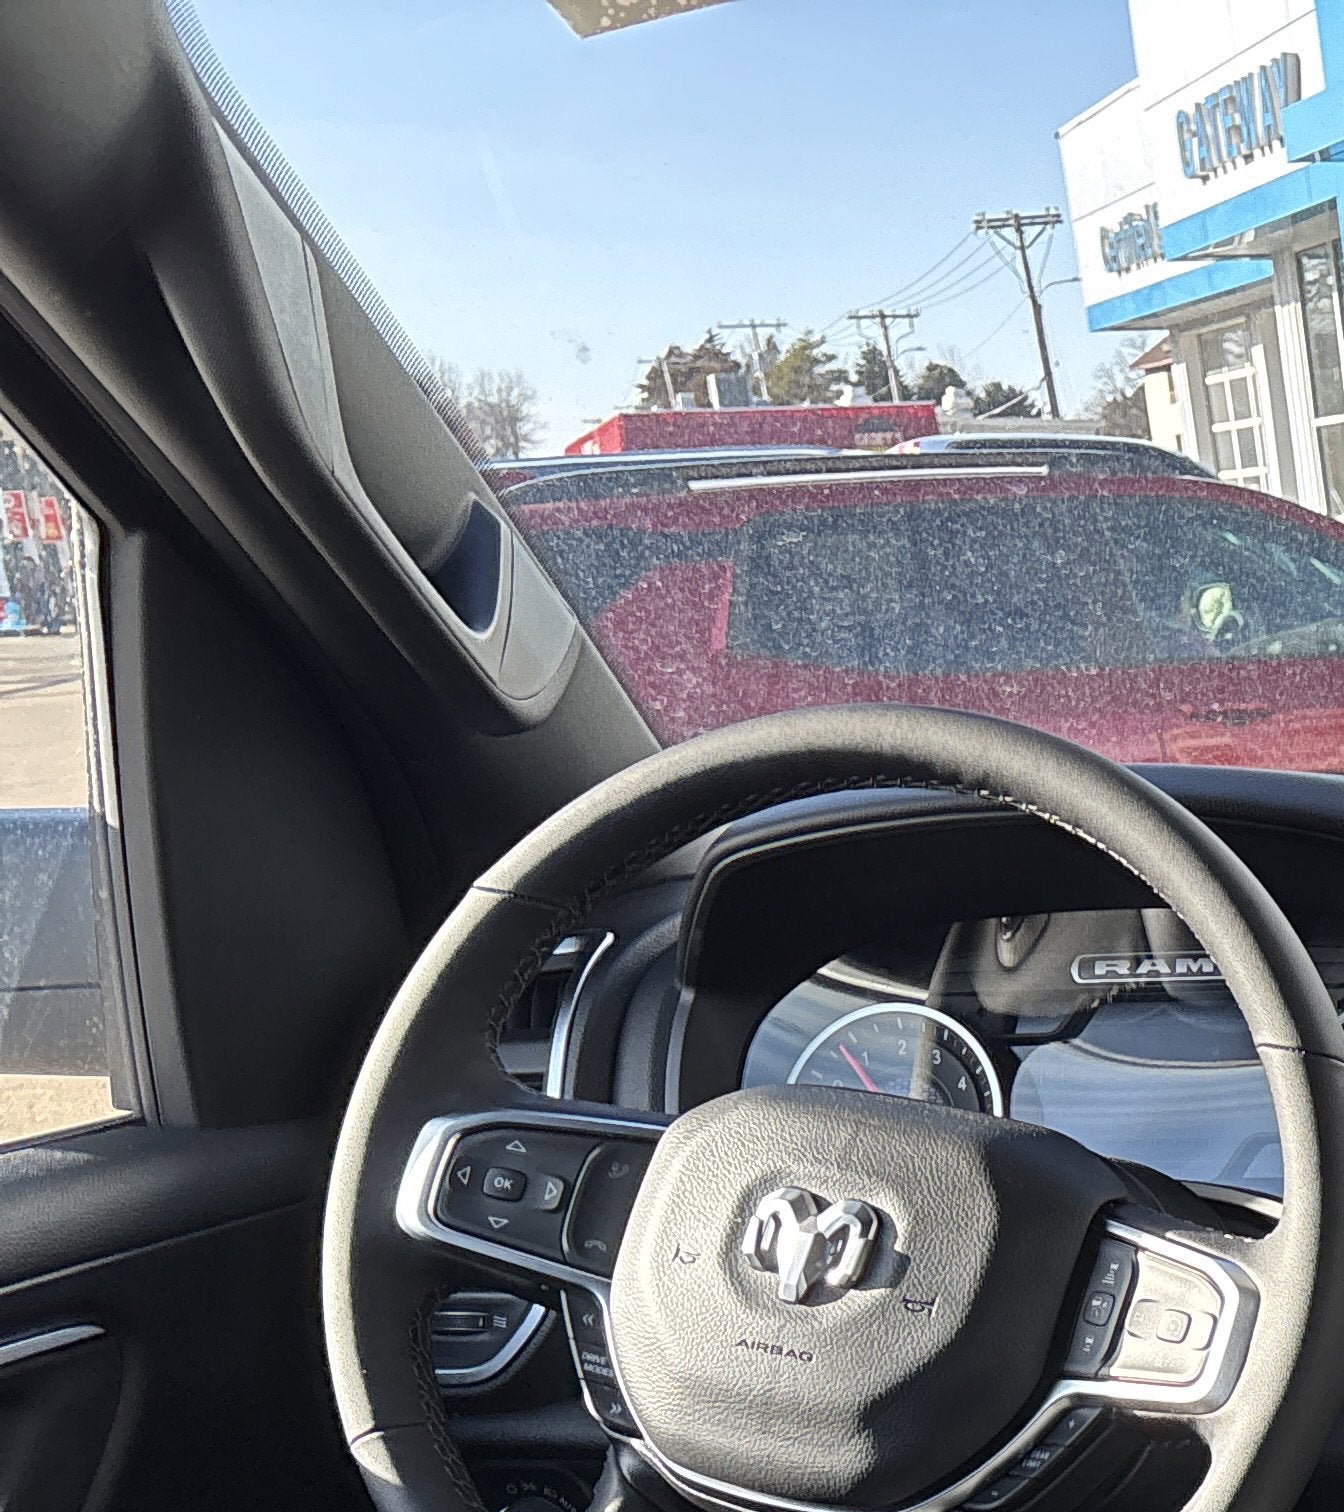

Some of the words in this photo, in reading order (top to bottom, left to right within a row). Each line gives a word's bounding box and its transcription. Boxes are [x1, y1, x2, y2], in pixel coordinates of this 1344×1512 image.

[1094, 958, 1214, 975] RAM
[897, 1040, 907, 1055] 2
[861, 1051, 869, 1066] 1
[932, 1050, 941, 1064] 3
[957, 1076, 967, 1091] 4
[494, 1177, 513, 1191] OK
[581, 1351, 607, 1365] DRIVE
[735, 1339, 813, 1362] AIRBAG
